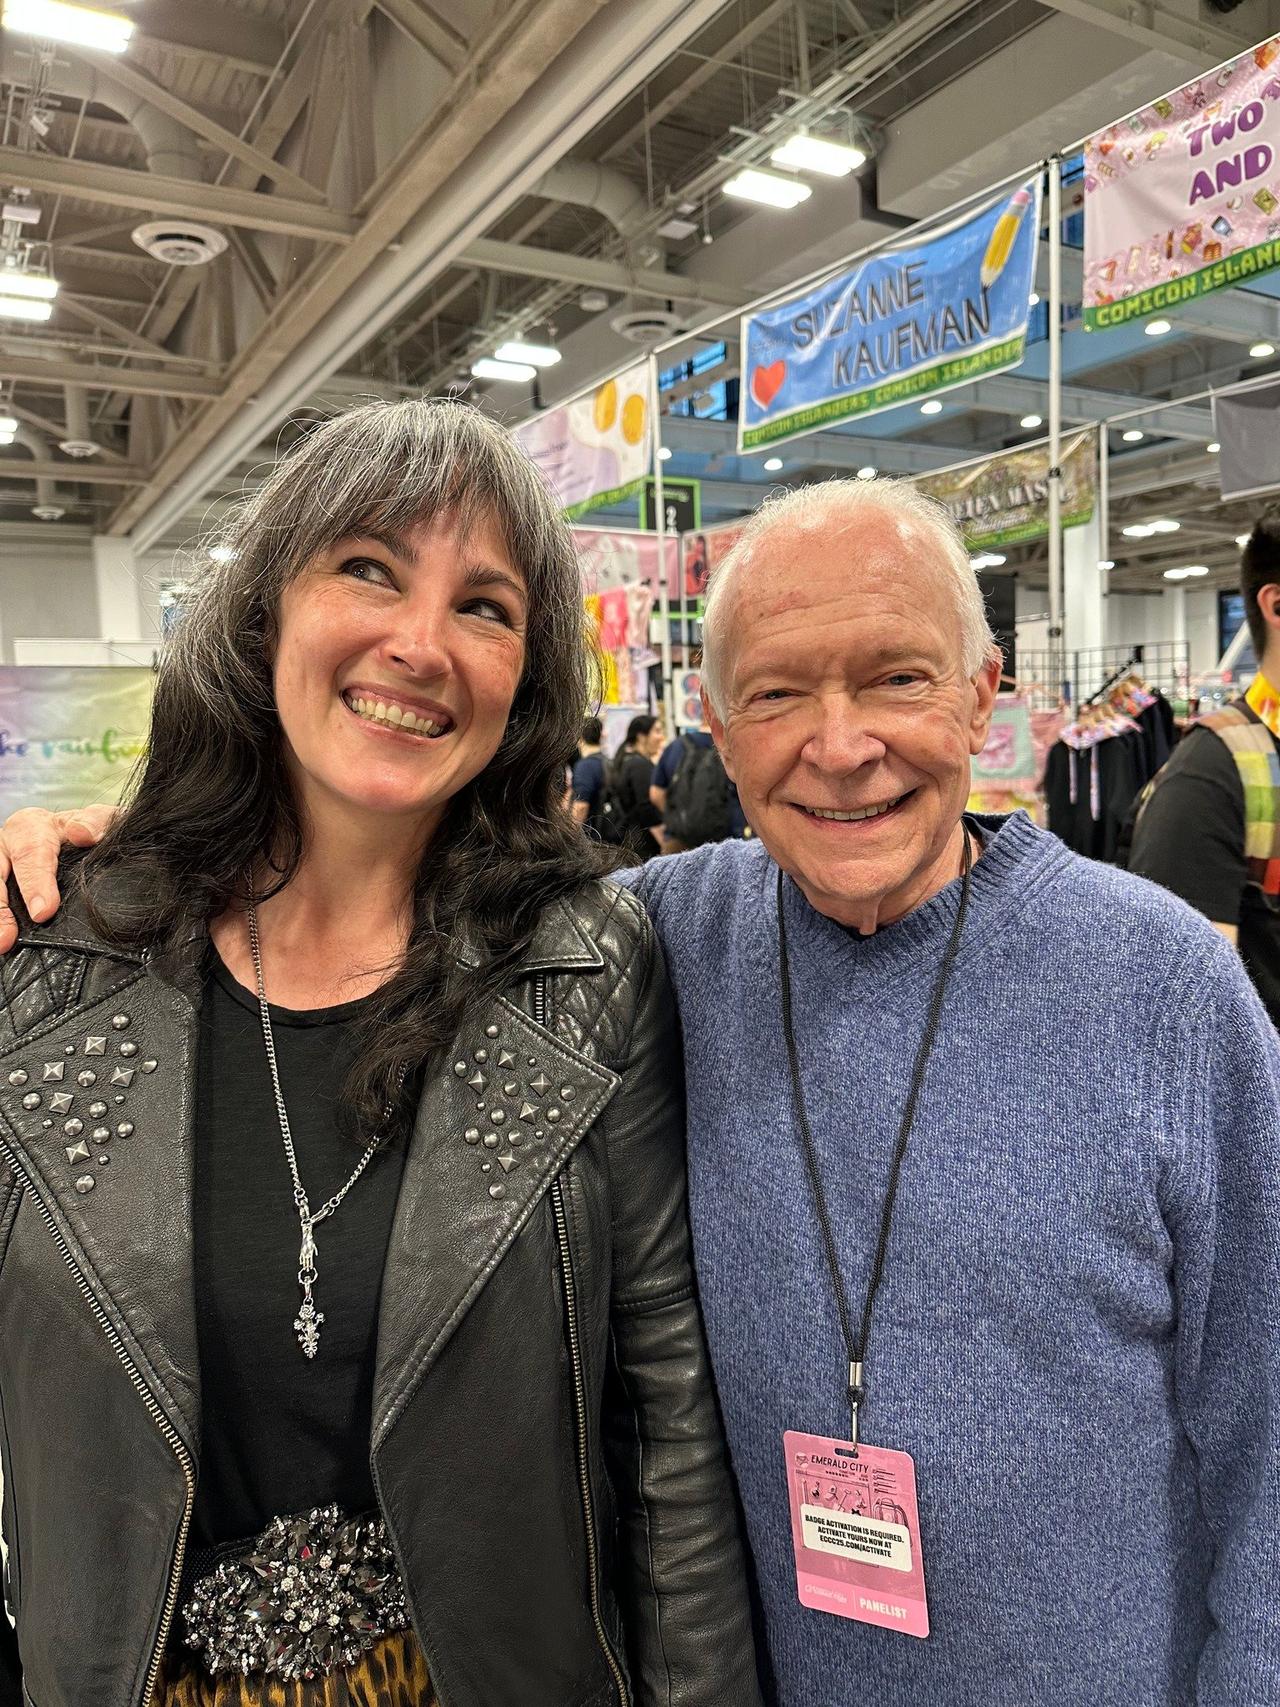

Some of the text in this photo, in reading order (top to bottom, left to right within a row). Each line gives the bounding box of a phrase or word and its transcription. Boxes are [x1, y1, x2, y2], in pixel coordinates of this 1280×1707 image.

[1187, 101, 1264, 157] TWO
[1189, 145, 1273, 206] AND
[790, 260, 928, 351] SUZANNE
[1096, 280, 1196, 327] COMICON
[832, 287, 990, 388] KAUFMAN
[811, 1454, 869, 1474] EMERALD CITY
[805, 1514, 825, 1526] BADGE
[826, 1519, 862, 1533] ACTIVATION
[870, 1529, 904, 1543] REQUIRED.
[818, 1526, 892, 1549] ACTIVATE YOURS NOW AT
[859, 1596, 907, 1620] PANELIST
